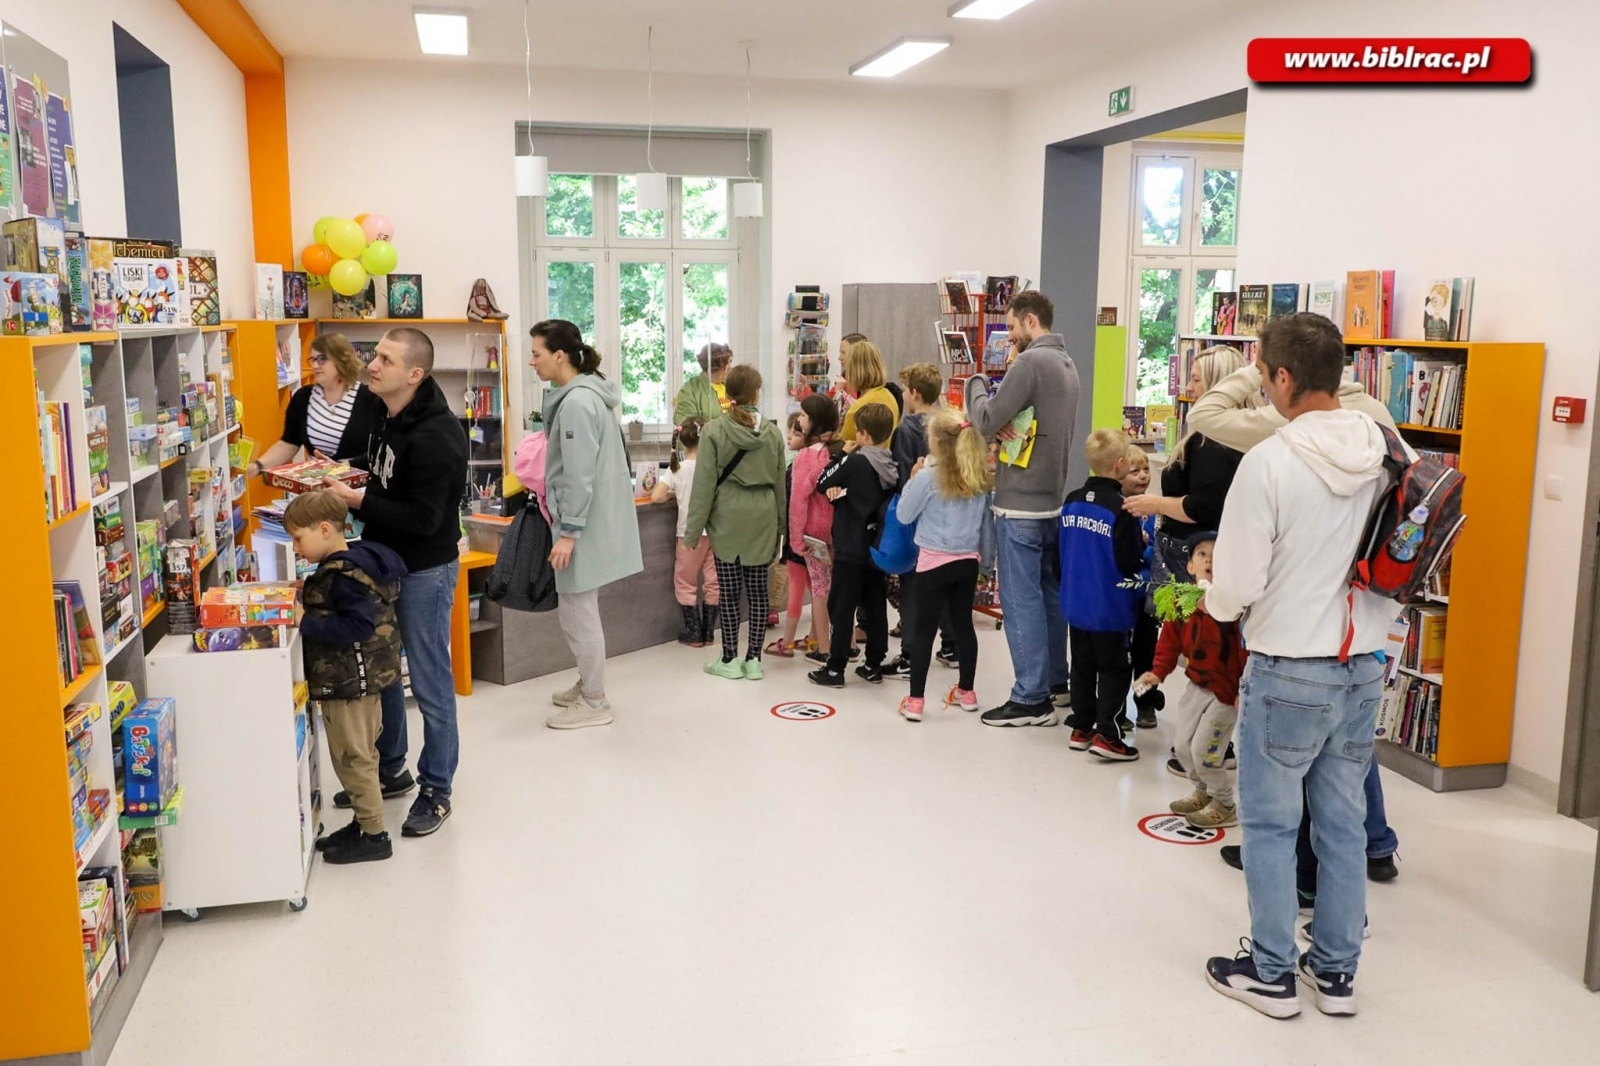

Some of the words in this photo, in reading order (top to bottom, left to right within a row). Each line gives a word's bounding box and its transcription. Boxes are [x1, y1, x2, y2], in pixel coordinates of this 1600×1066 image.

[113, 241, 165, 258] lchemicy
[1169, 361, 1177, 390] SZTUKA
[1378, 698, 1390, 726] KOSMOS
